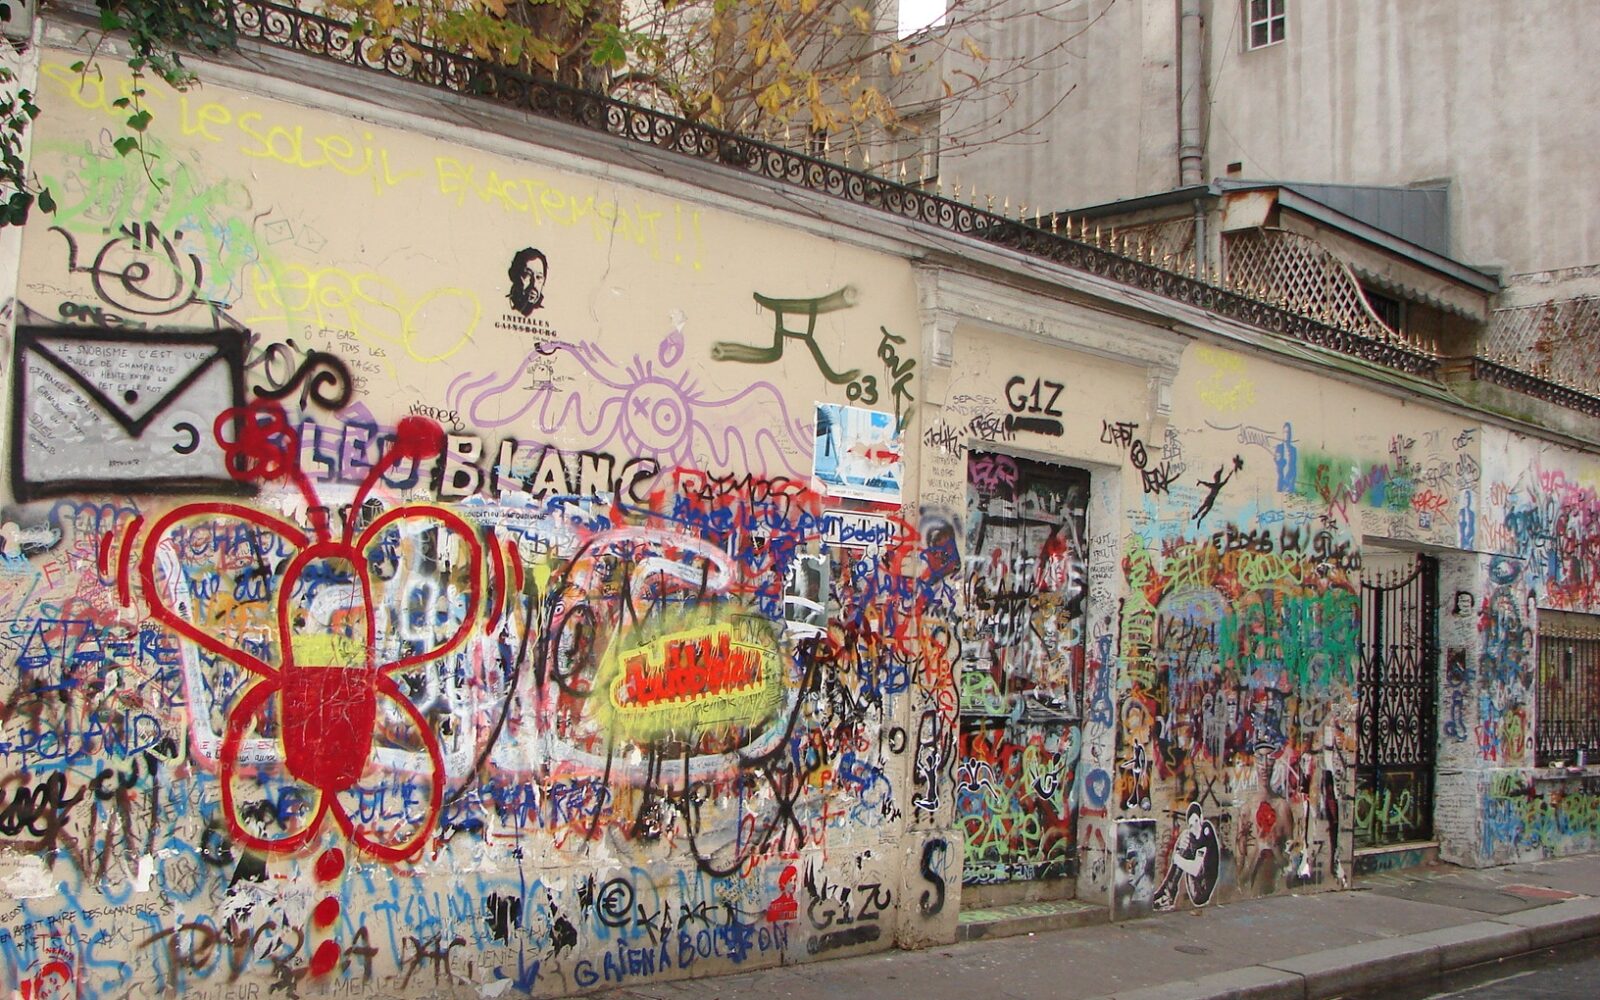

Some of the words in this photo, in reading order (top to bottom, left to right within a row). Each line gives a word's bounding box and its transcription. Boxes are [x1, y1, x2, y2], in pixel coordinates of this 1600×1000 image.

[502, 314, 550, 328] INITIALES
[494, 321, 558, 337] GAINSBOURG
[77, 345, 128, 357] SNOBISME
[119, 362, 176, 374] CHAMPAGNE
[438, 432, 661, 510] BLANC
